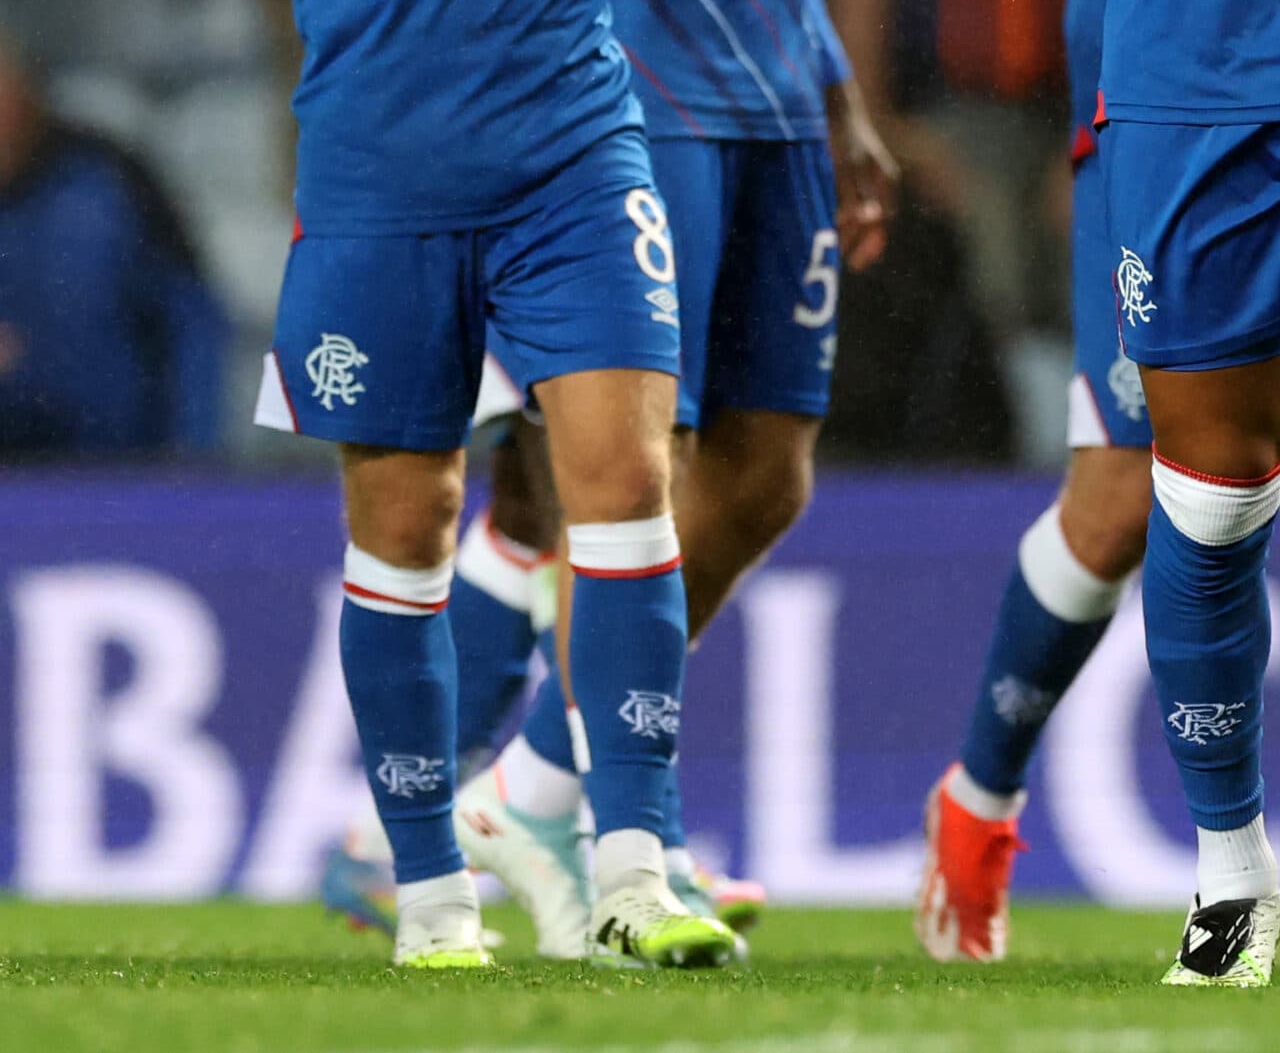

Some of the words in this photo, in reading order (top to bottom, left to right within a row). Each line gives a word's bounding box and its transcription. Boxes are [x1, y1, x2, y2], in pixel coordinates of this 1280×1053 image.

[624, 188, 677, 285] 8
[794, 229, 838, 328] 5
[8, 562, 932, 905] BAL
